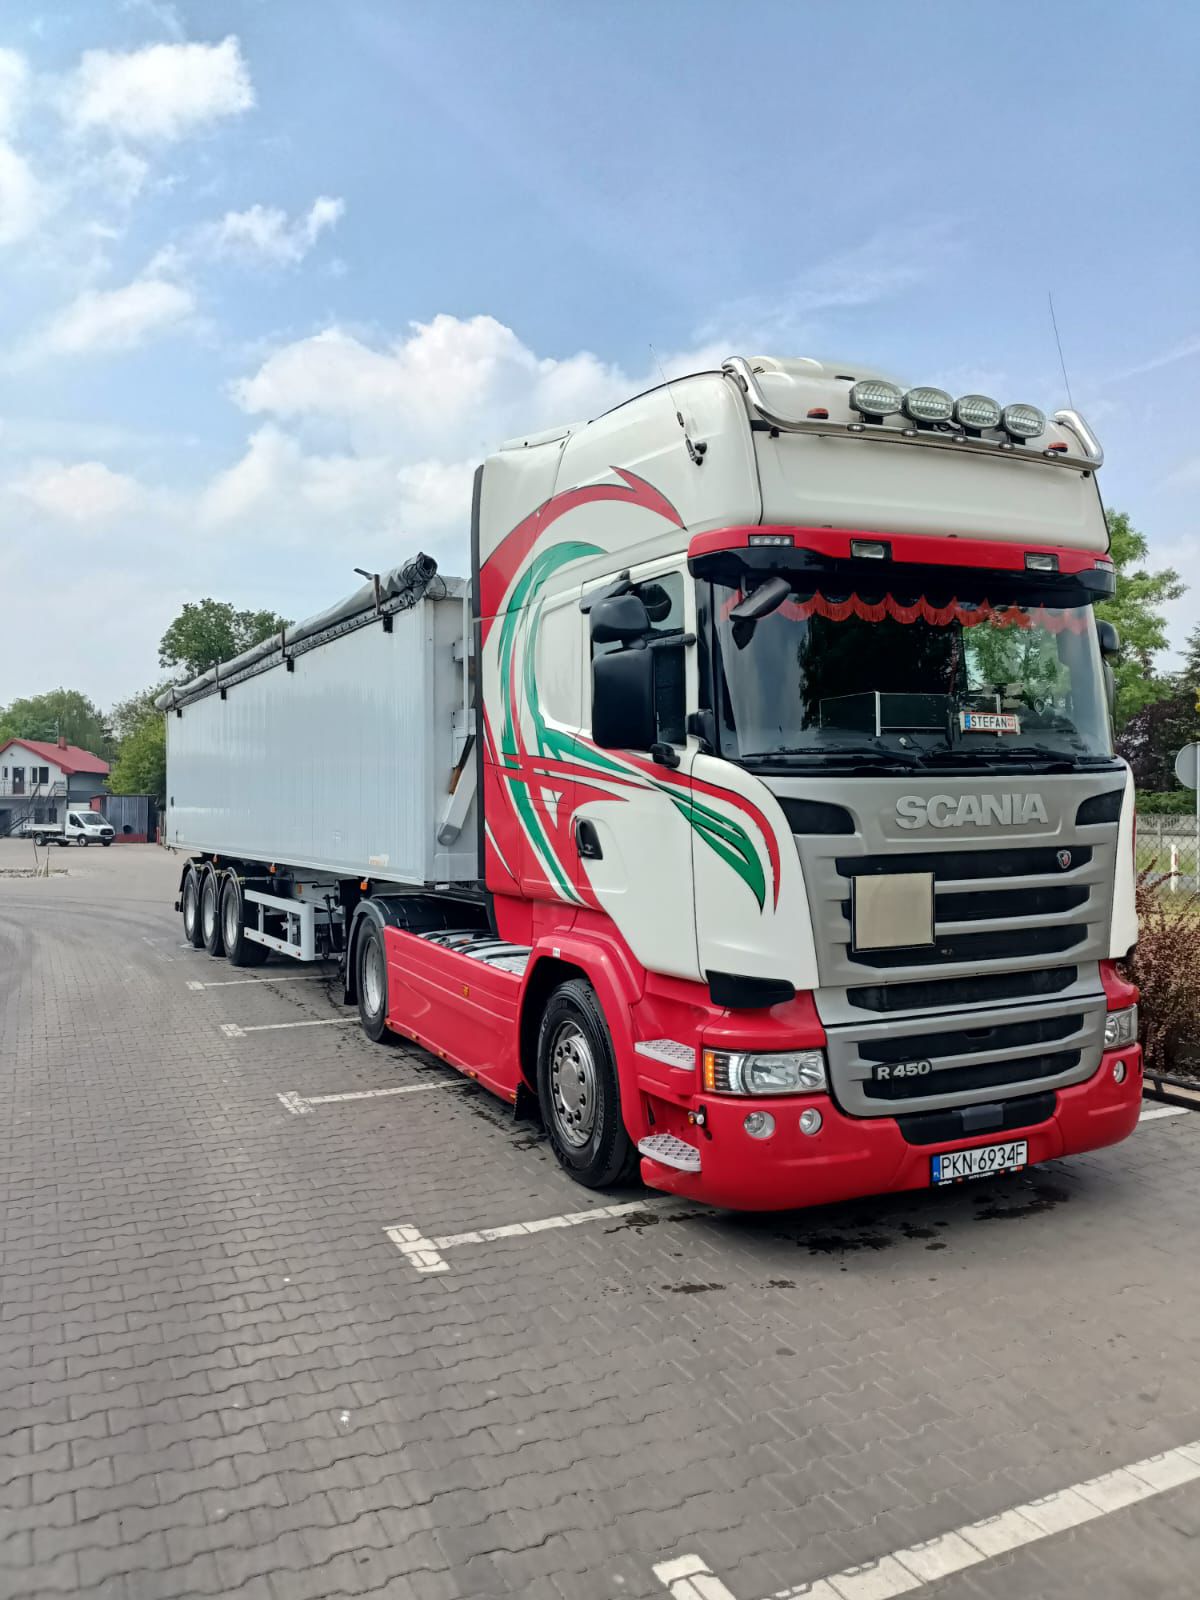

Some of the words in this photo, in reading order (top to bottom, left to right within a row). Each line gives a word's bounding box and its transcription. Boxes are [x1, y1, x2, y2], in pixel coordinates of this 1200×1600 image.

[971, 716, 1008, 728] STEFAN
[896, 793, 1049, 829] SCANIA
[877, 1066, 890, 1080] R
[893, 1062, 930, 1077] 450
[941, 1152, 973, 1178] PKN
[977, 1143, 1025, 1170] 6934F
